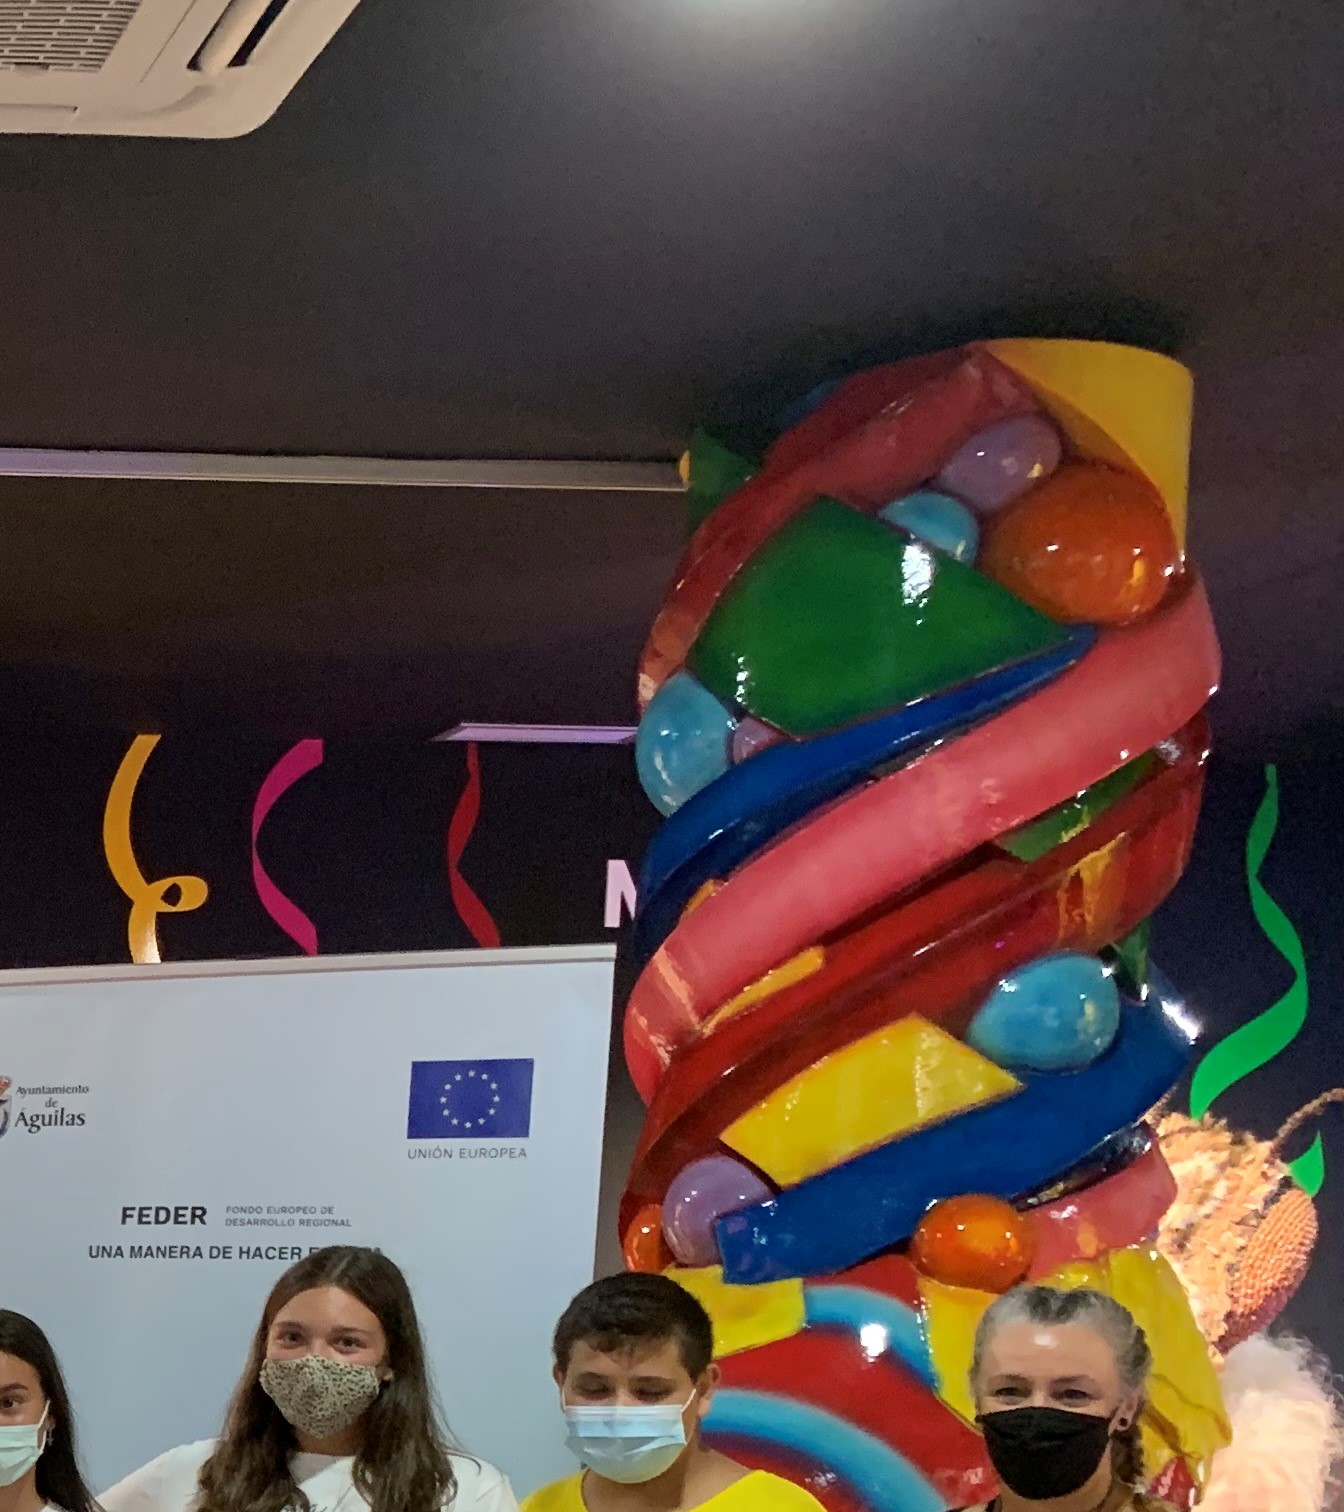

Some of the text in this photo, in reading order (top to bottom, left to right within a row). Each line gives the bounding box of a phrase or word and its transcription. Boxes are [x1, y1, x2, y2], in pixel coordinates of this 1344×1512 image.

[15, 1084, 90, 1099] Ayuntamiento
[44, 1097, 59, 1109] de
[14, 1107, 87, 1135] Águilas
[407, 1145, 528, 1160] UNIÓN EUROPEA
[120, 1205, 208, 1226] FEDER
[225, 1205, 334, 1215] FONDO EUROPEO DE
[224, 1217, 352, 1228] DESARROLLO REGIONAL
[88, 1245, 125, 1259] UNA
[129, 1245, 204, 1260] MANERA
[208, 1245, 233, 1260] DE
[238, 1246, 302, 1261] HACER
